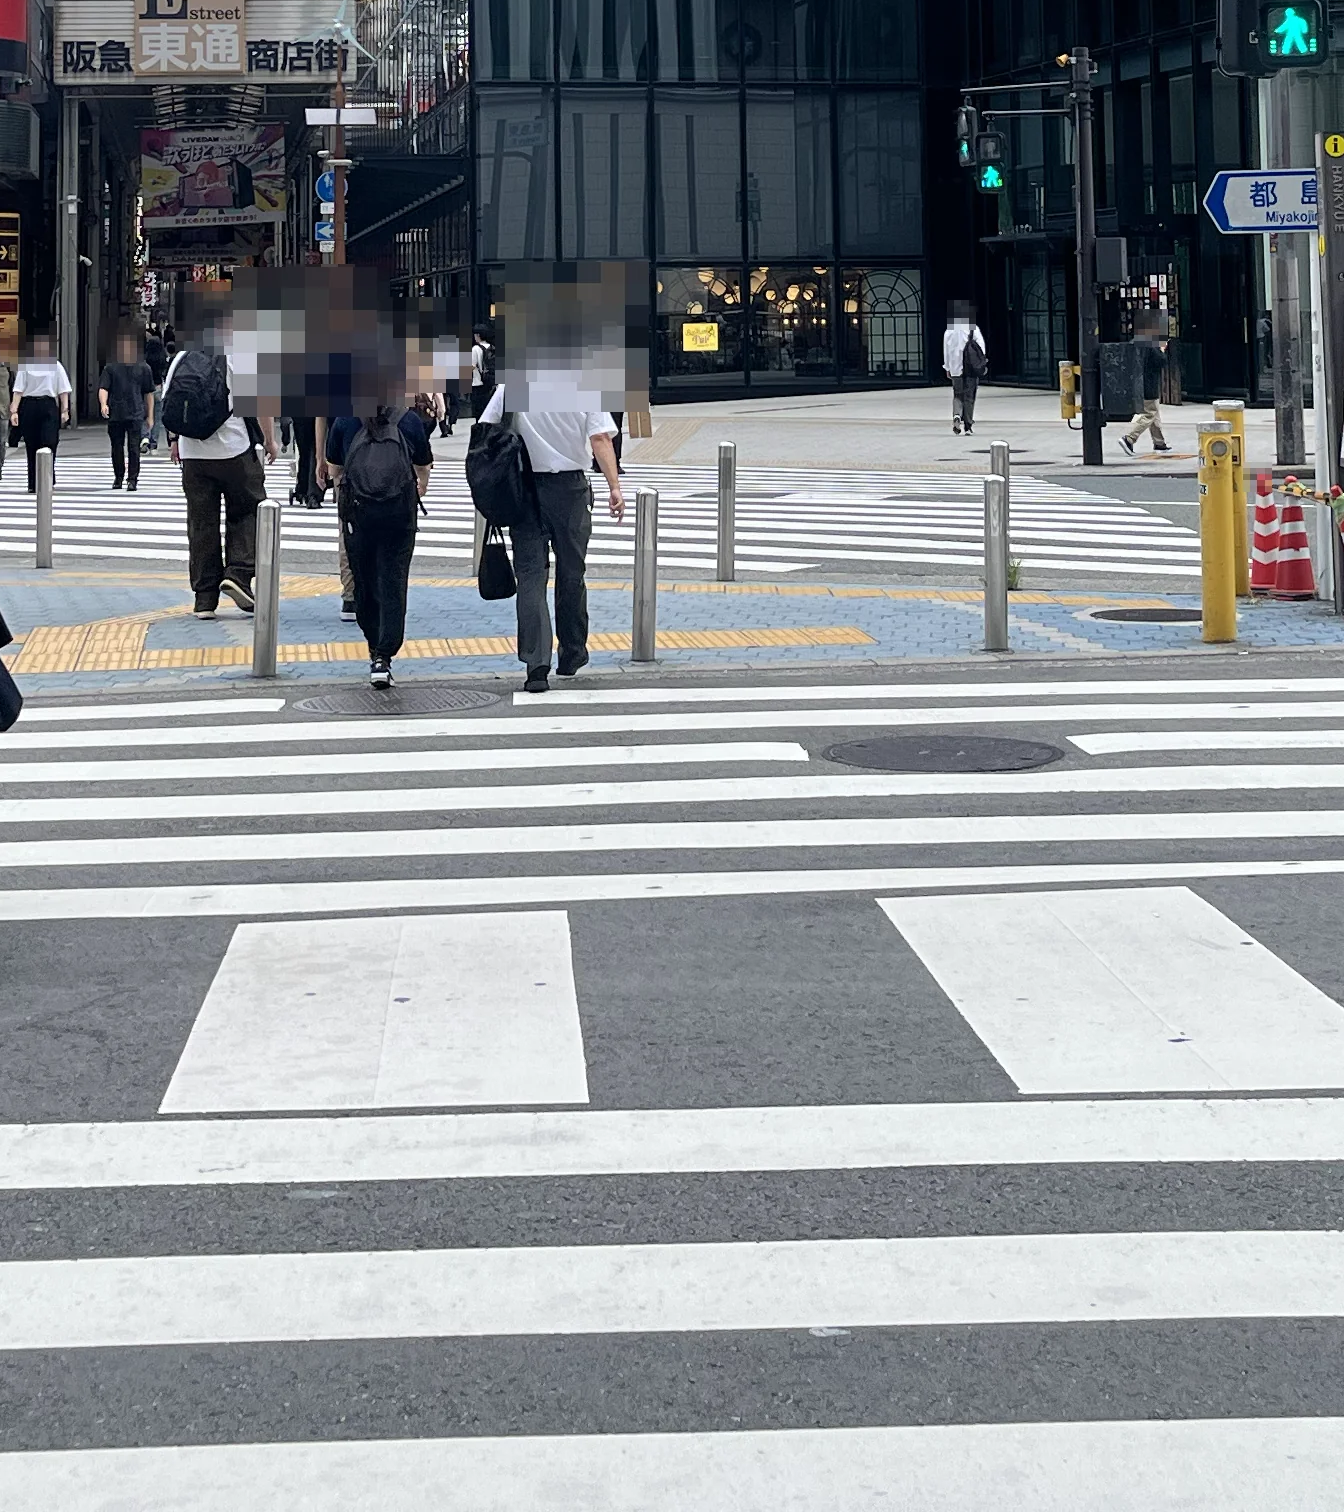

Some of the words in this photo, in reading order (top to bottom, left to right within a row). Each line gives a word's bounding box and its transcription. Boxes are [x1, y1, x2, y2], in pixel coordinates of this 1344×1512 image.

[62, 39, 134, 74] 阪急
[138, 23, 242, 72] 東通
[247, 39, 349, 73] 商店街
[1332, 165, 1344, 221] HANKYU
